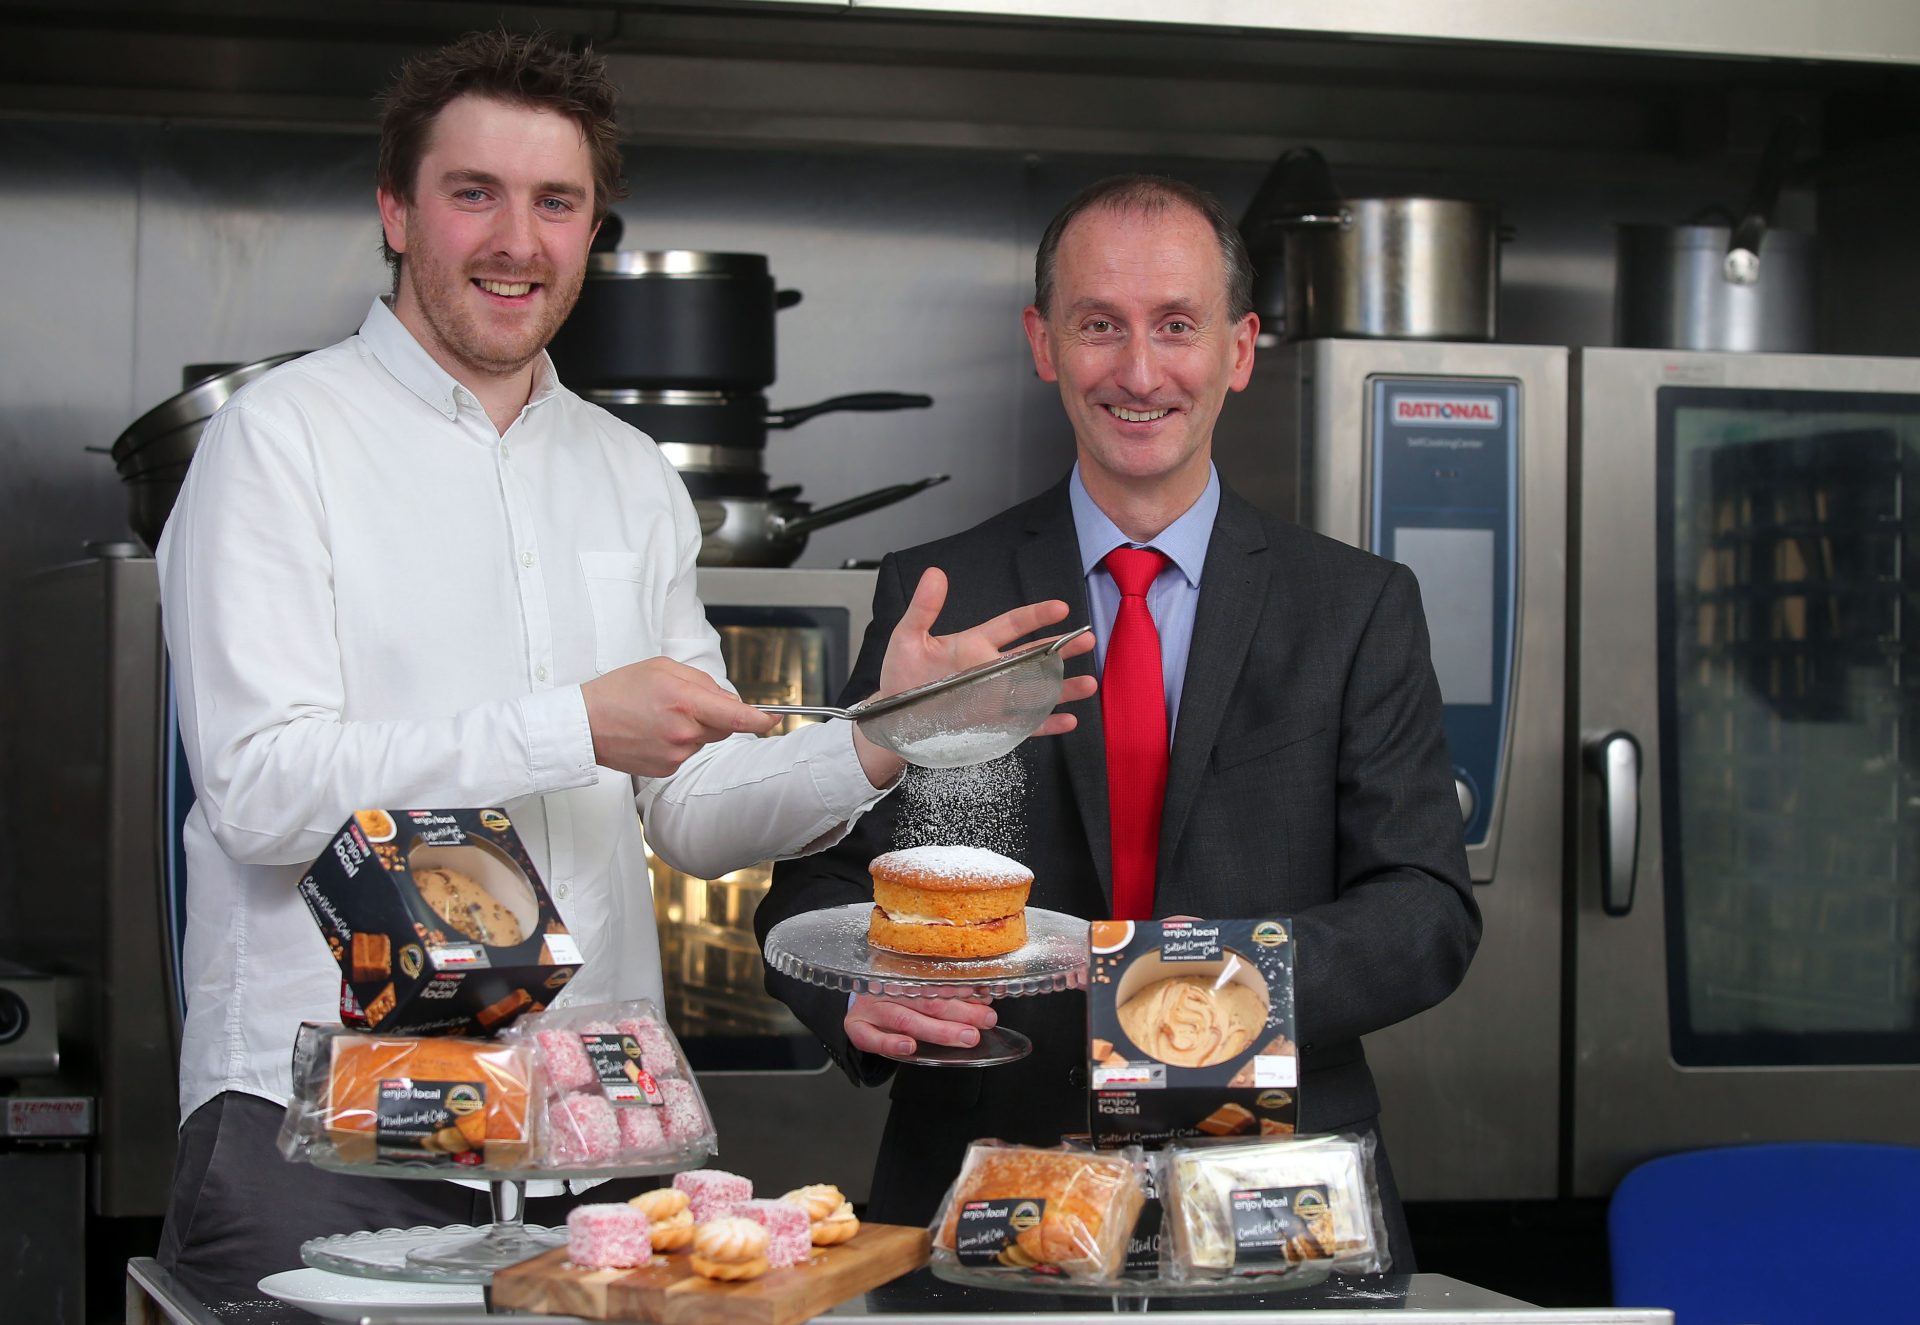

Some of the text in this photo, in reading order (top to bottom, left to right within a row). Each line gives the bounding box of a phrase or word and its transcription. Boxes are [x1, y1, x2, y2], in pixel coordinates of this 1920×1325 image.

[1398, 402, 1494, 419] RATIONAL
[343, 832, 364, 865] enjoy
[333, 838, 359, 878] local
[1164, 941, 1187, 954] Salted
[428, 980, 461, 990] enjoy
[420, 988, 458, 999] local
[13, 1102, 84, 1113] STEPHENS
[1098, 1096, 1137, 1107] enjoy
[1098, 1104, 1140, 1115] local
[1098, 1132, 1131, 1144] Salted
[1132, 1128, 1175, 1142] Caramel
[1128, 1238, 1151, 1254] alted
